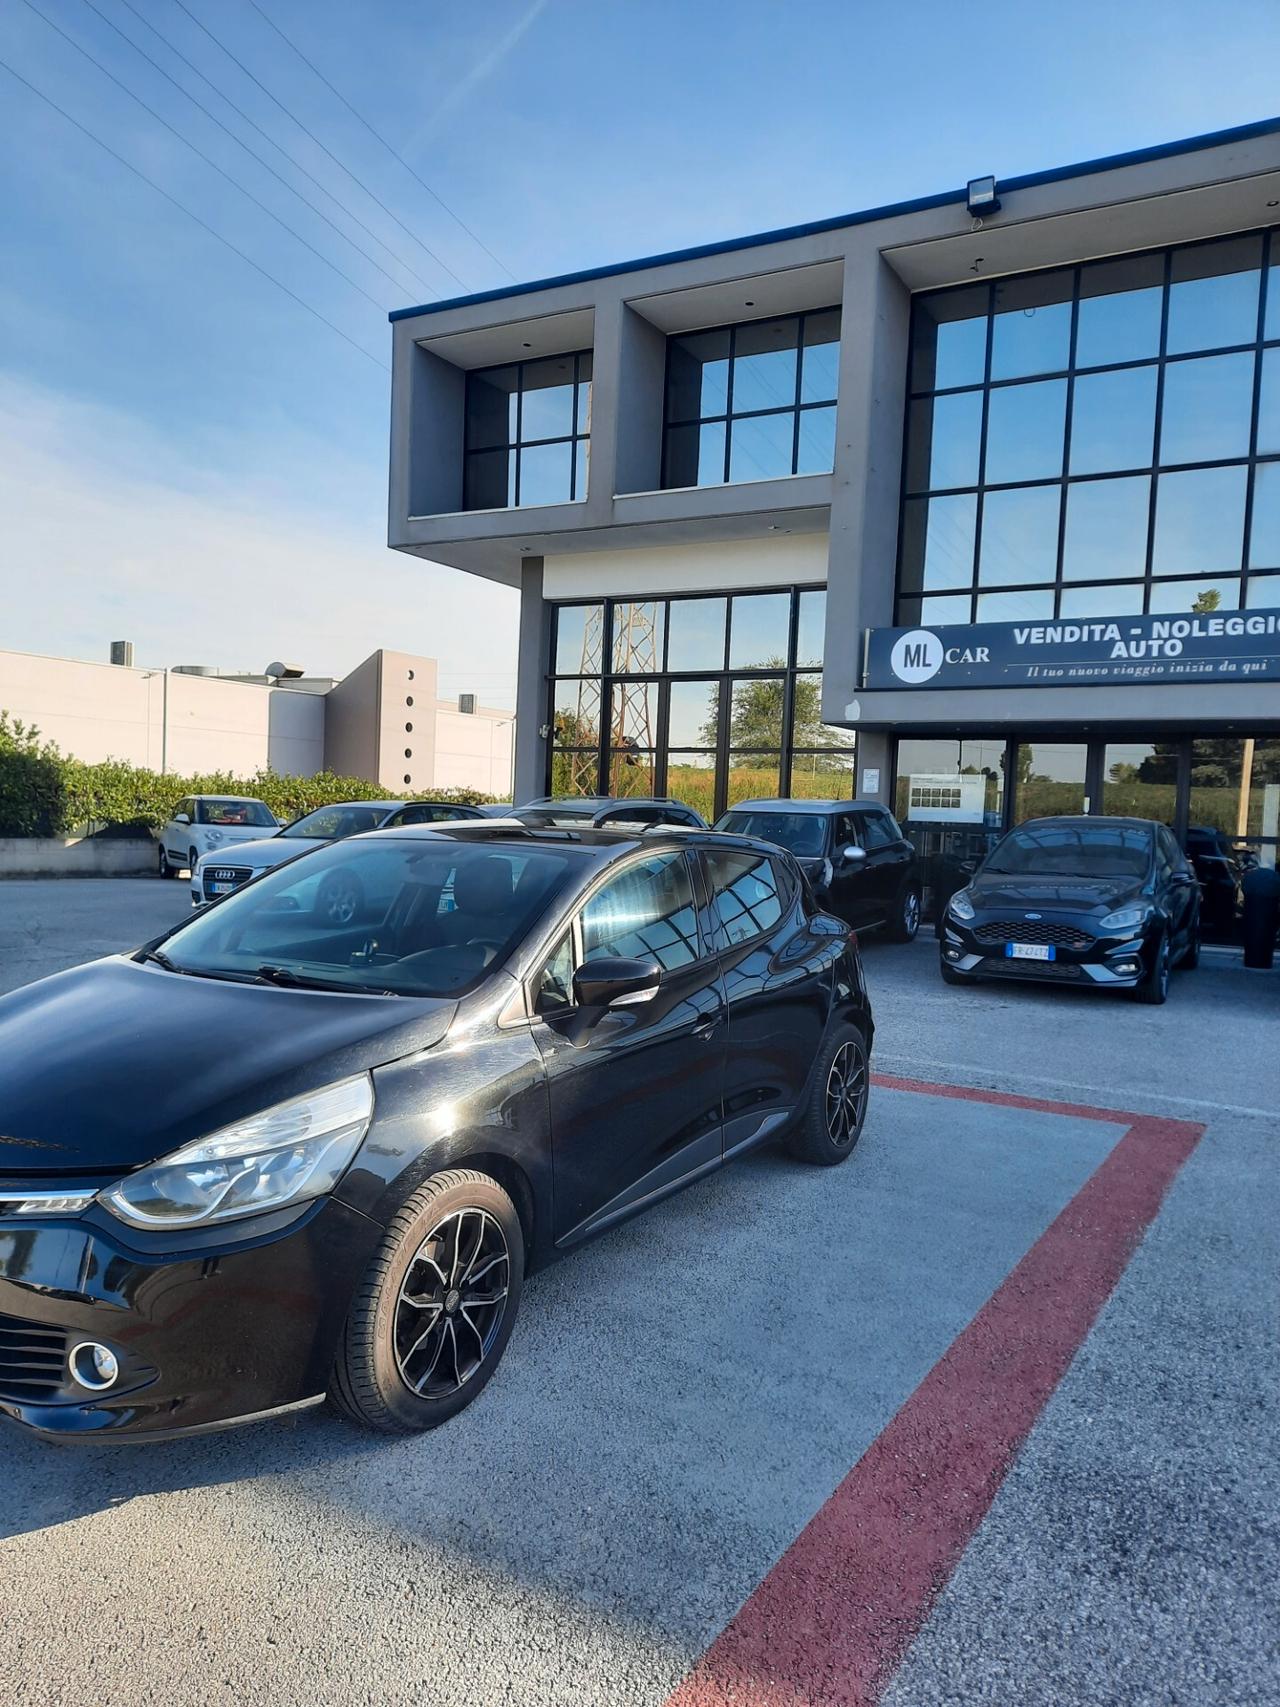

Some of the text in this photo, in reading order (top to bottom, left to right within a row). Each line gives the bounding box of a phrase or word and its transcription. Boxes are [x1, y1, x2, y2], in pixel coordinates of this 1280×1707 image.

[1013, 623, 1122, 645] VENDITA
[1152, 615, 1280, 639] NOLEGGI
[903, 643, 991, 668] ML CAR
[1110, 639, 1183, 658] AUTO
[1027, 659, 1268, 677] Il tuo nuovo viaggio inizia da qui
